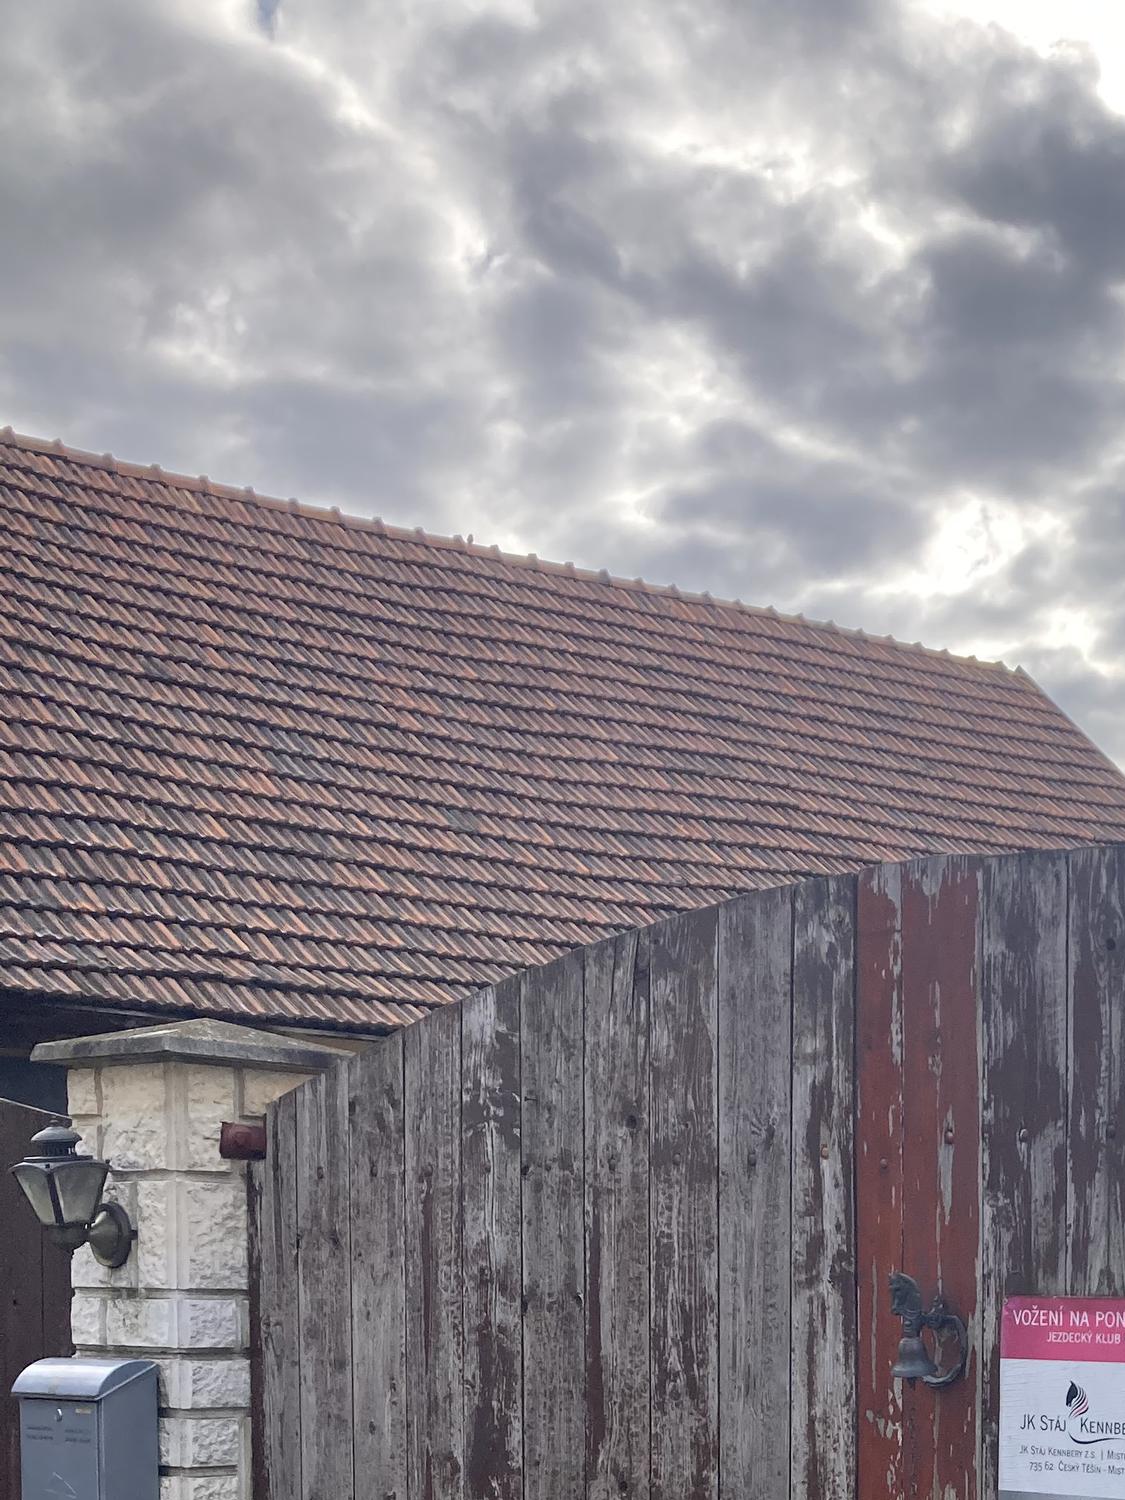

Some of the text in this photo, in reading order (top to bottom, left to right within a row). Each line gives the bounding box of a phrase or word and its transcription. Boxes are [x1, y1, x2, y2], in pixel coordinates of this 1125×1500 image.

[1013, 1306, 1063, 1327] VOŽENÍ
[1070, 1311, 1089, 1327] NA
[1047, 1330, 1092, 1344] JEZDECKÝ
[1096, 1333, 1120, 1344] KLUB
[1020, 1414, 1035, 1430] JK
[1019, 1445, 1029, 1454] JK
[1044, 1461, 1054, 1471] 62
